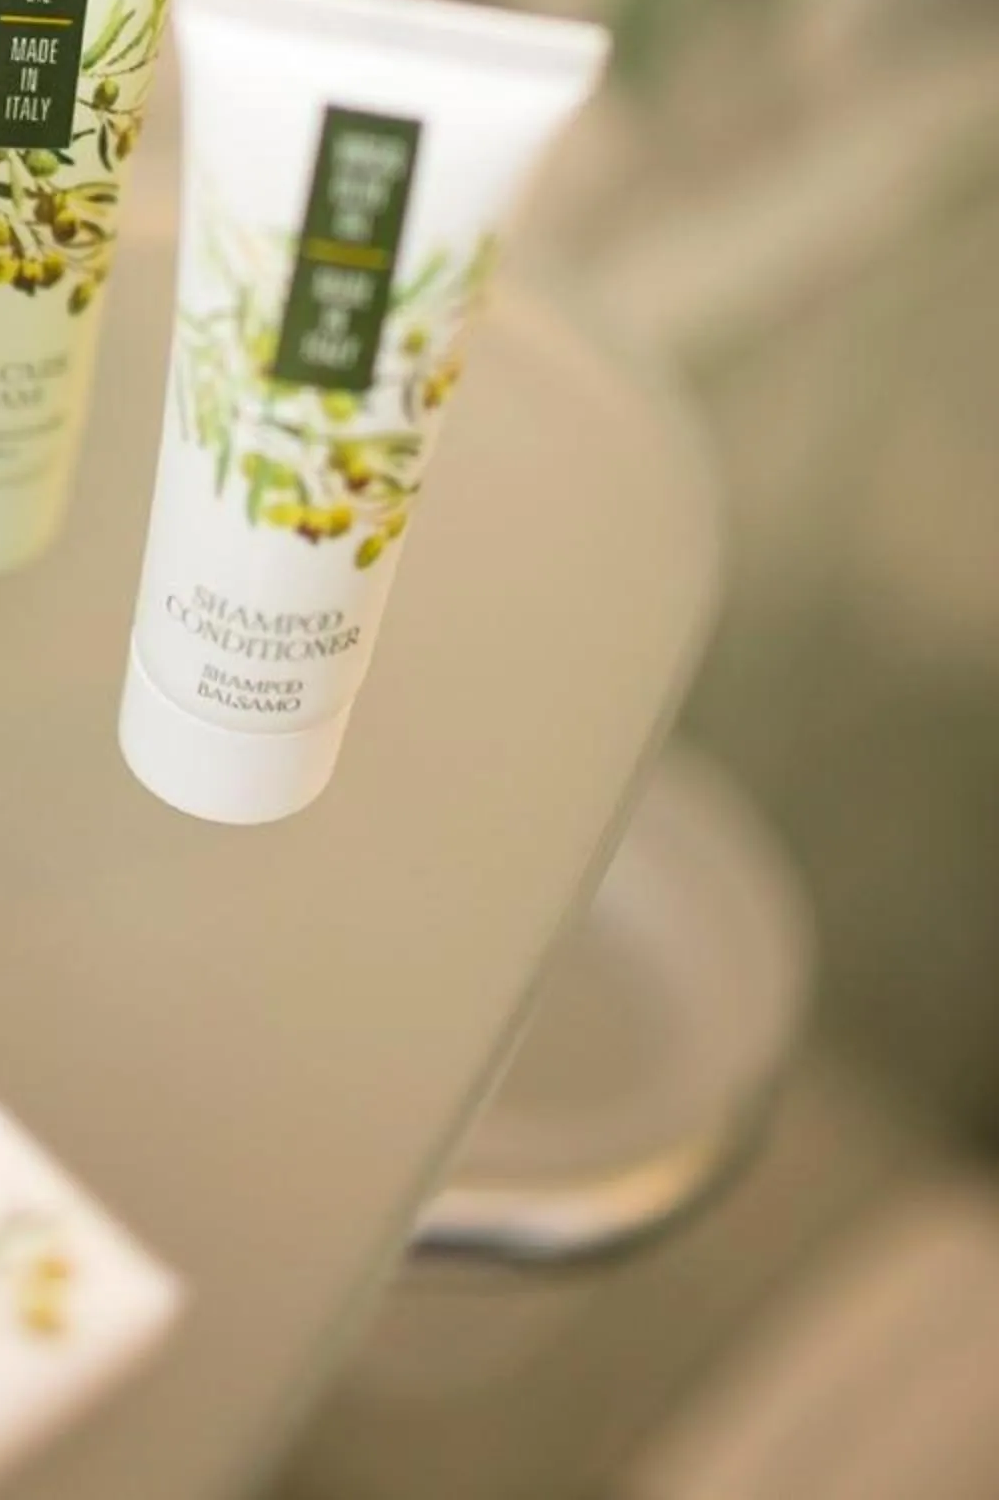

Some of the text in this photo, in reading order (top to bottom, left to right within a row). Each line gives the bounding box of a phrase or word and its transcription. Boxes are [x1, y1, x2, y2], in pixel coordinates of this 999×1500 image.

[10, 37, 59, 65] MADE
[20, 68, 39, 94] IN
[4, 96, 52, 122] ITALY
[164, 593, 362, 663] CONDITIONER
[192, 583, 346, 638] SHAMPOO
[200, 662, 305, 697] SHAMPOO
[195, 680, 303, 715] BALSAMO
